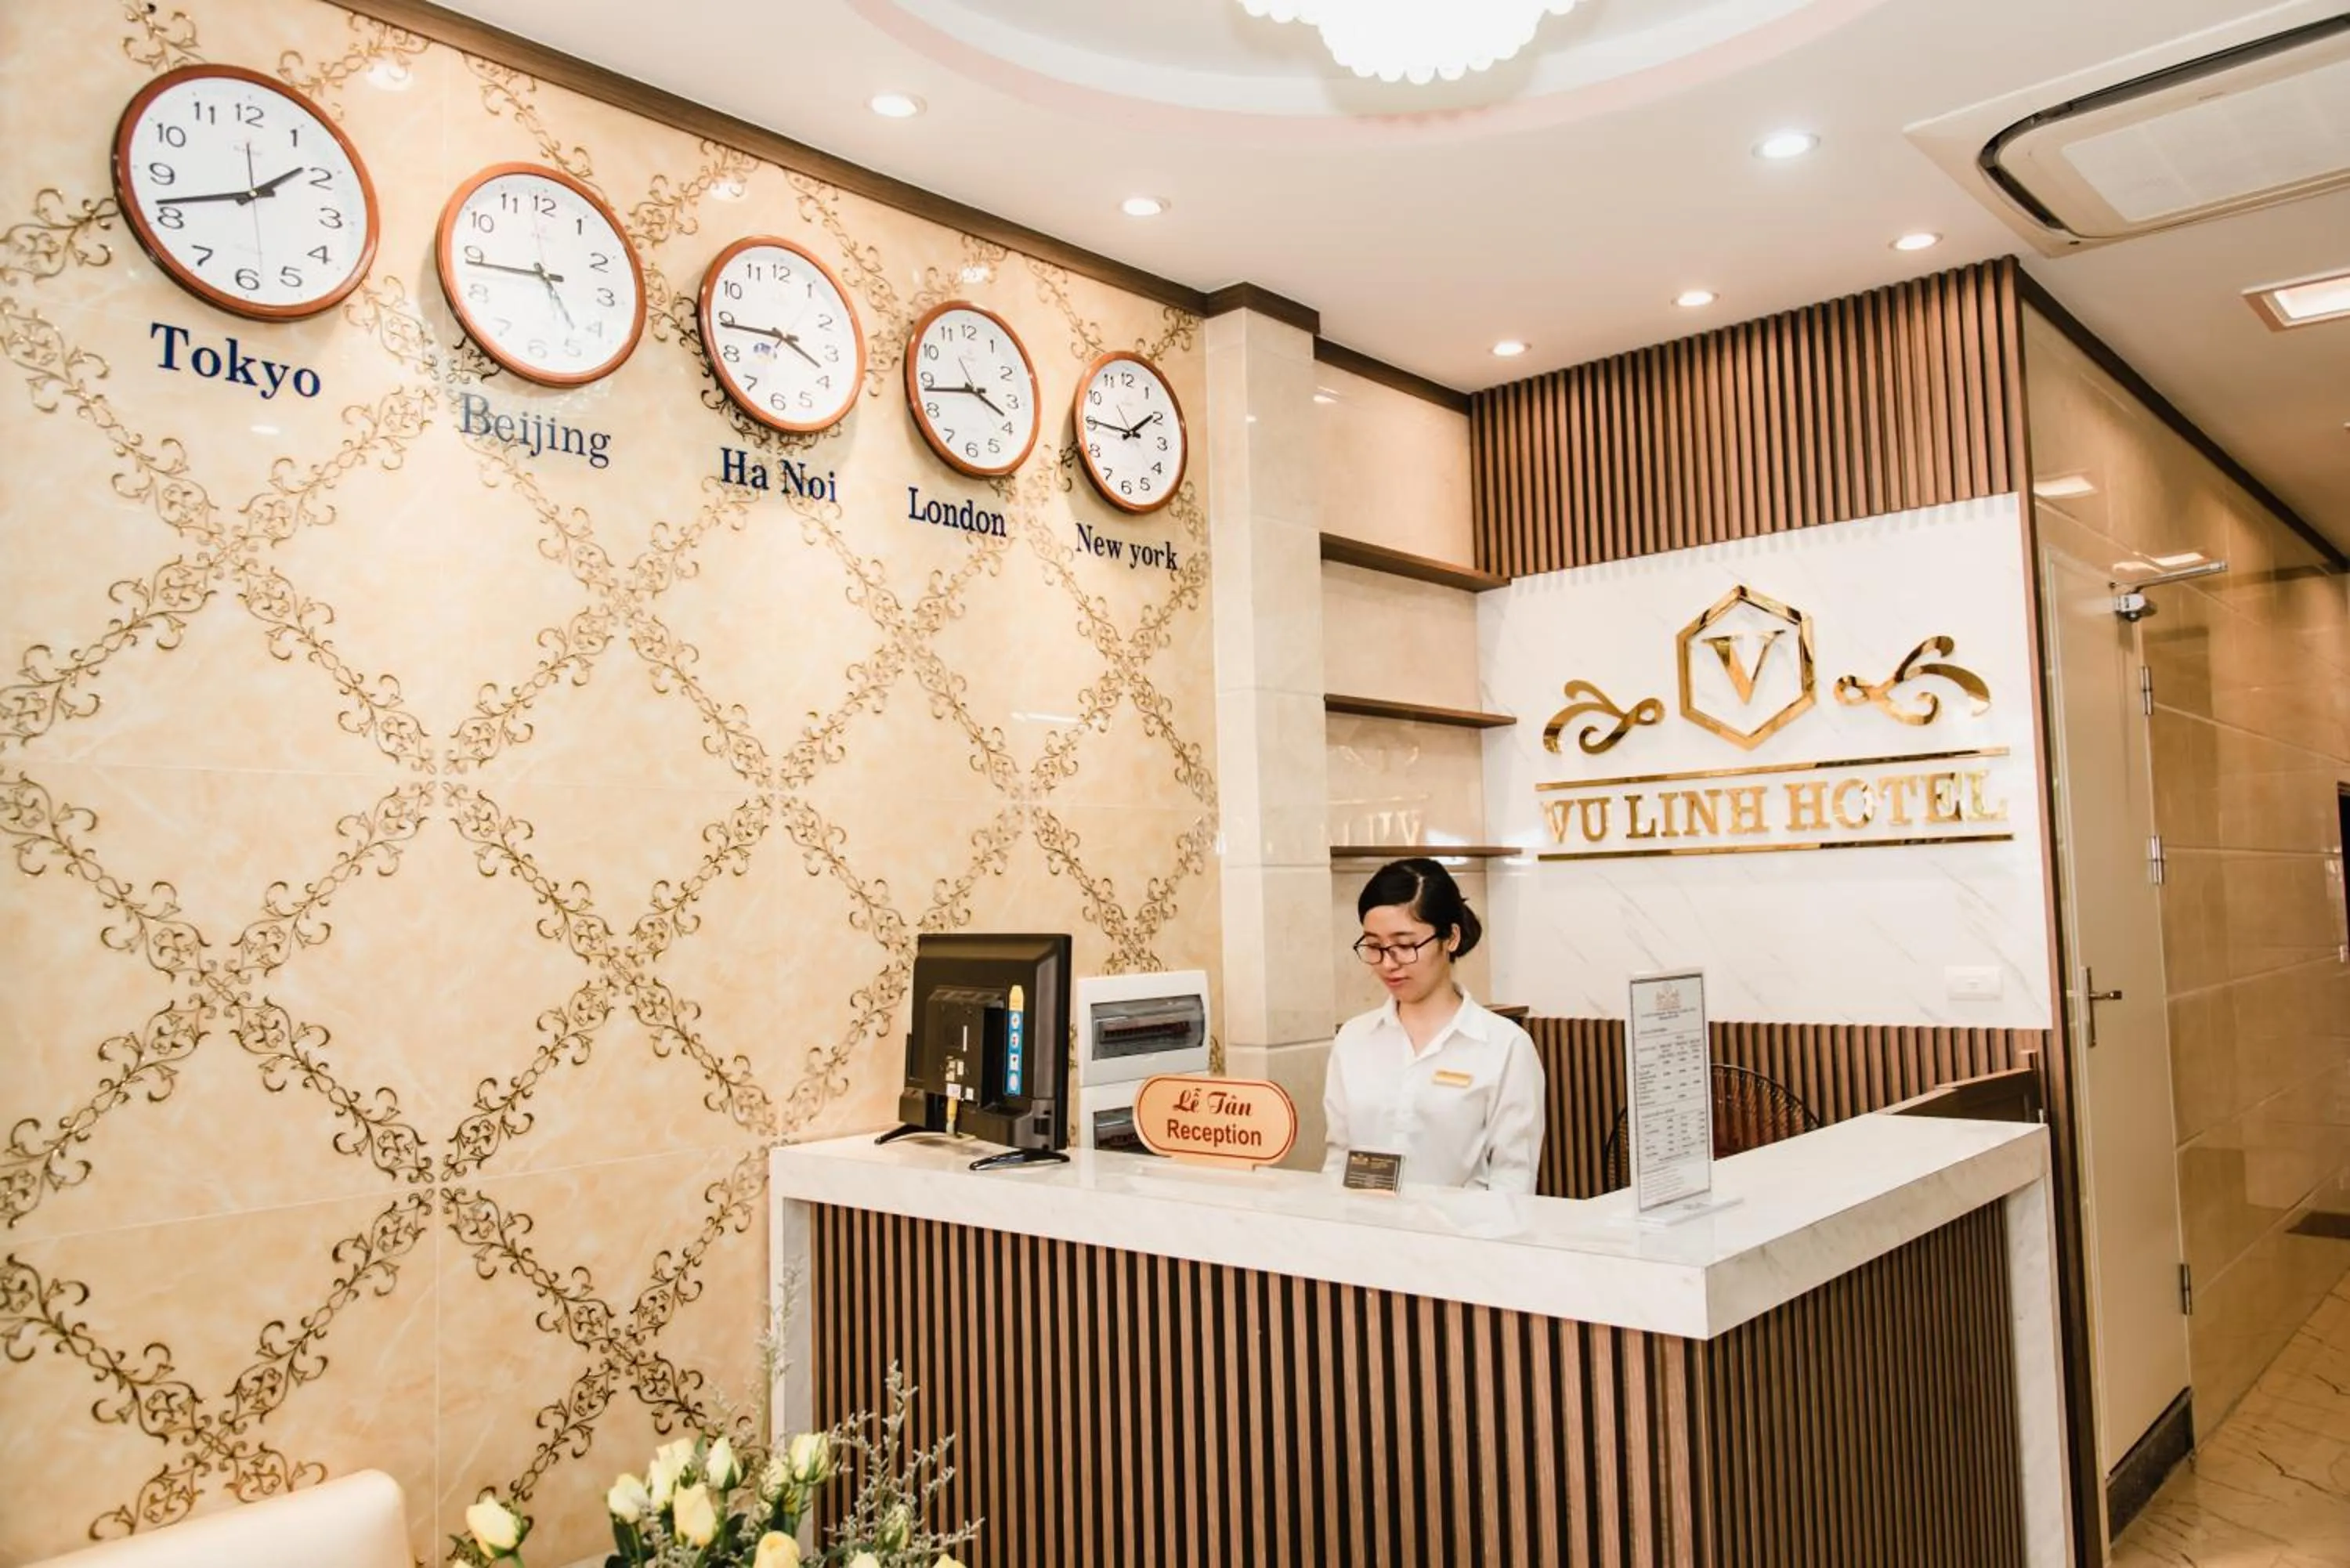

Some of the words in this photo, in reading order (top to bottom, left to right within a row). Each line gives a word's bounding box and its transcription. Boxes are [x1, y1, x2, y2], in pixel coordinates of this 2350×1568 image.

[193, 101, 216, 125] 11
[235, 102, 264, 128] 12
[157, 123, 186, 147] 10
[290, 128, 298, 147] 1
[149, 162, 175, 186] 9
[309, 167, 333, 190] 2
[501, 193, 519, 213] 11
[533, 194, 556, 217] 12
[157, 207, 184, 229] 8
[318, 208, 342, 229] 3
[472, 211, 494, 233] 10
[576, 218, 583, 235] 1
[190, 244, 214, 267] 7
[306, 245, 331, 265] 4
[464, 245, 485, 264] 9
[589, 253, 609, 273] 2
[234, 269, 260, 291] 6
[279, 266, 302, 287] 5
[747, 263, 761, 281] 11
[772, 263, 790, 283] 12
[468, 284, 489, 304] 8
[596, 287, 615, 307] 3
[724, 280, 743, 299] 10
[807, 284, 812, 298] 1
[494, 318, 512, 337] 7
[719, 311, 736, 327] 9
[818, 313, 833, 331] 2
[585, 319, 603, 338] 4
[940, 326, 953, 341] 11
[961, 324, 977, 340] 12
[527, 338, 547, 359] 6
[563, 338, 581, 358] 5
[723, 345, 739, 363] 8
[824, 345, 839, 363] 3
[924, 344, 939, 360] 10
[989, 340, 994, 353] 1
[150, 322, 321, 399] Tokyo
[816, 375, 830, 388] 4
[920, 371, 935, 388] 9
[1000, 366, 1013, 381] 2
[1104, 374, 1115, 388] 11
[1121, 372, 1135, 388] 12
[744, 374, 757, 392] 7
[771, 392, 786, 410] 6
[798, 392, 813, 408] 5
[1007, 394, 1018, 409] 3
[1088, 389, 1101, 406] 10
[1144, 386, 1149, 399] 1
[927, 403, 940, 418] 8
[1152, 411, 1163, 425] 2
[459, 392, 611, 469] Beijing
[1002, 421, 1013, 435] 4
[1086, 415, 1097, 431] 9
[943, 428, 954, 443] 7
[1156, 437, 1168, 451] 3
[966, 442, 978, 457] 6
[988, 439, 1000, 453] 5
[1089, 444, 1101, 458] 8
[721, 447, 769, 490] Ha
[781, 460, 837, 502] Noi
[1103, 468, 1112, 480] 7
[1152, 462, 1162, 474] 4
[1121, 481, 1132, 495] 6
[1140, 478, 1151, 491] 5
[908, 487, 1007, 537] London
[1076, 522, 1122, 559] New
[1130, 541, 1177, 571] york
[1701, 629, 1786, 706] V
[1540, 797, 1613, 844] VU
[1624, 785, 1770, 840] LINH
[1782, 768, 2010, 833] HOTEL
[1173, 1088, 1202, 1113] Lễ
[1207, 1091, 1253, 1116] Tân
[1167, 1119, 1261, 1147] Reception
